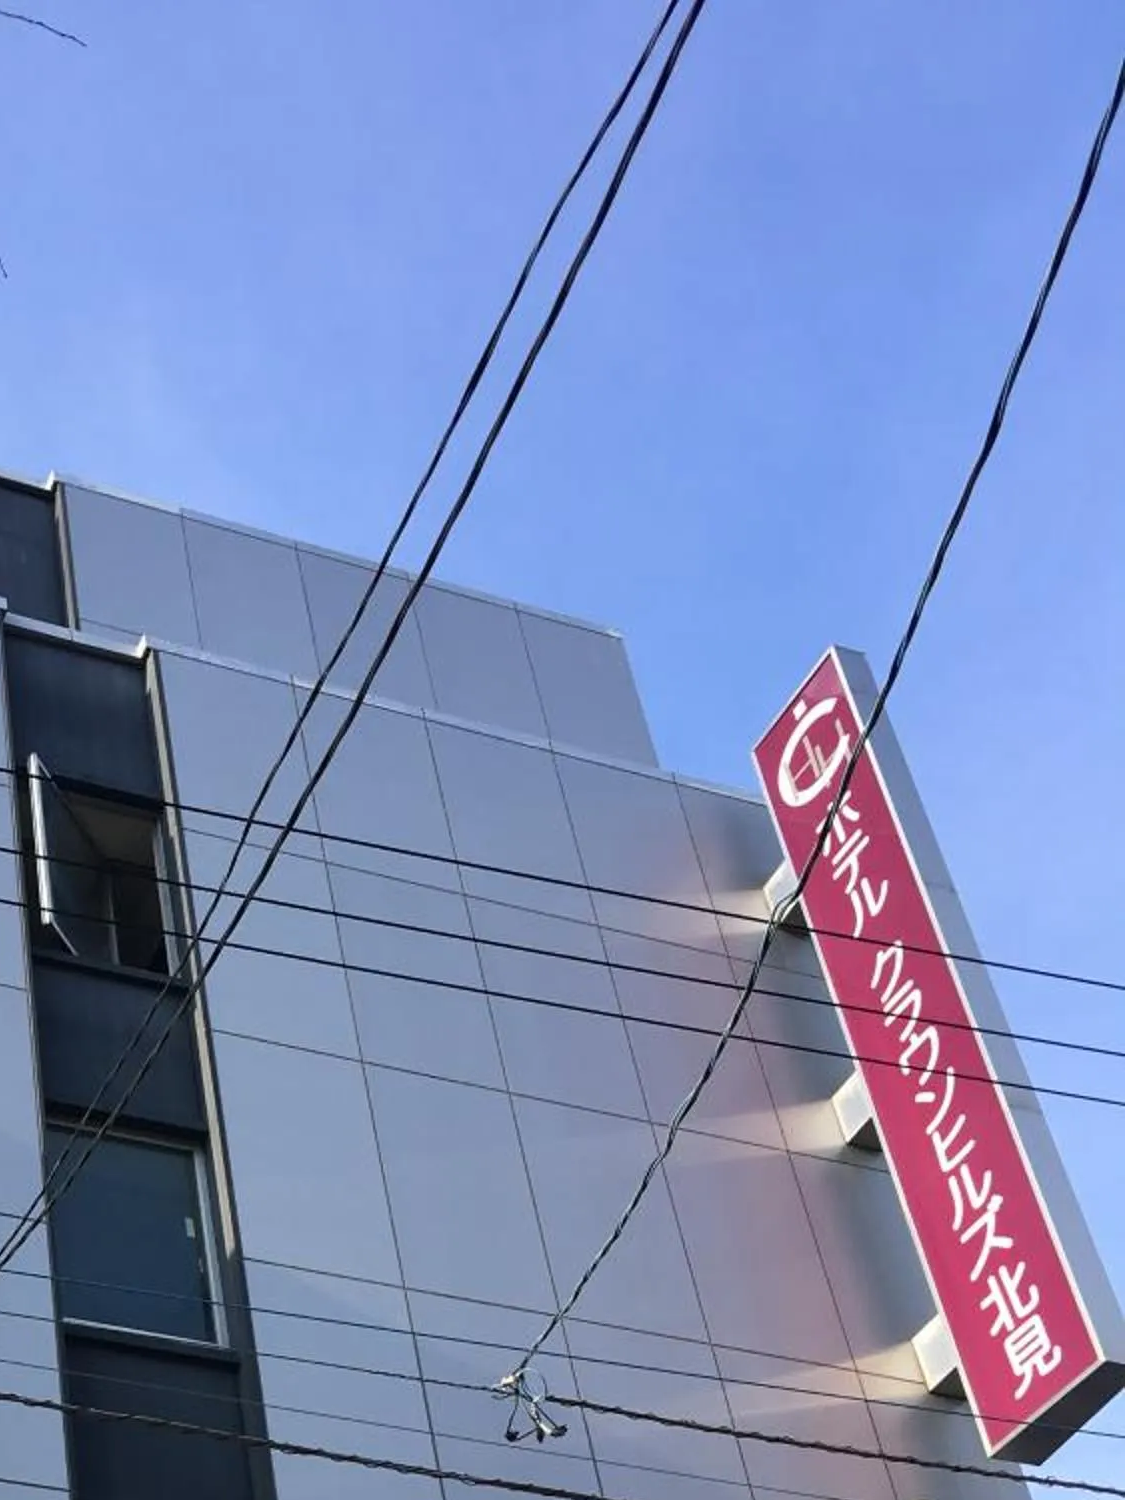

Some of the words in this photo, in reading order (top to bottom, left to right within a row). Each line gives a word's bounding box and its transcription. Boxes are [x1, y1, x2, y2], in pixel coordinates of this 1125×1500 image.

[815, 789, 889, 938] ホテル
[870, 940, 1062, 1400] クラウンヒルズ北見
